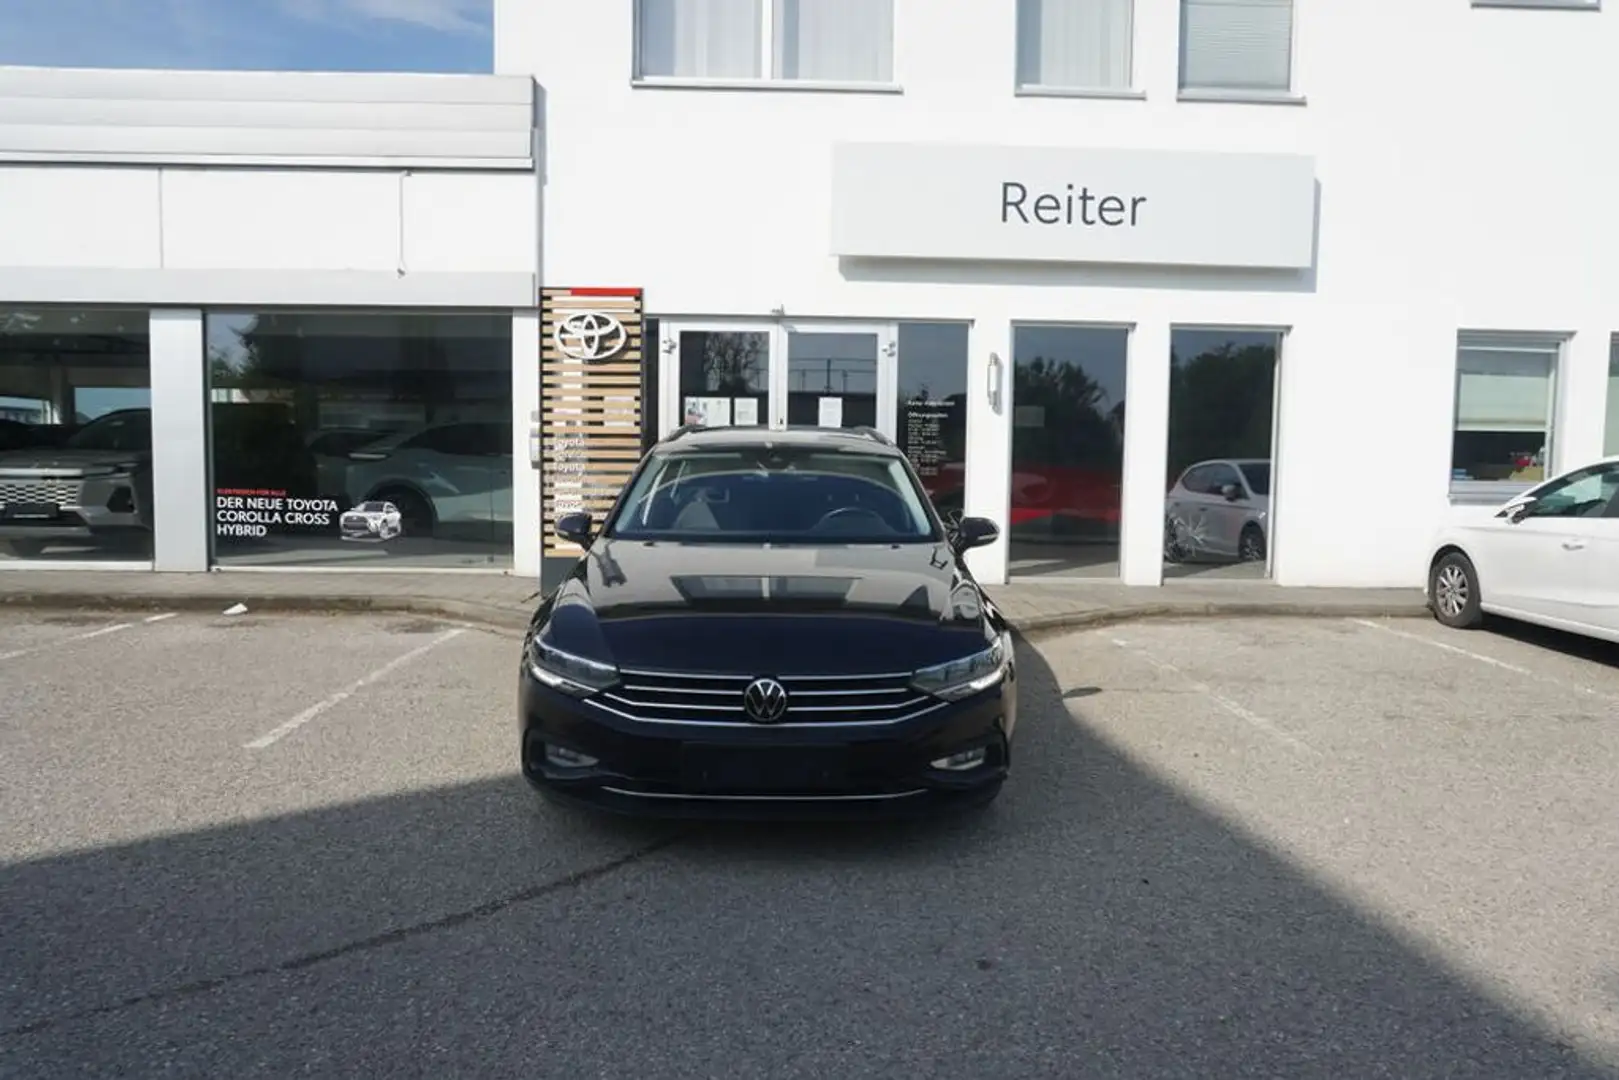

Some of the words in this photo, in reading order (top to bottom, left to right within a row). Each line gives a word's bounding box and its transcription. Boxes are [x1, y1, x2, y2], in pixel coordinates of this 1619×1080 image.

[1000, 181, 1147, 227] Reiter
[216, 497, 243, 509] DER
[246, 498, 283, 511] NEUE
[286, 499, 339, 512] TOYOTA
[216, 510, 282, 524] COROLLA
[285, 512, 330, 525] CROSS
[216, 524, 267, 537] HYBRID
[744, 678, 787, 722] VW
